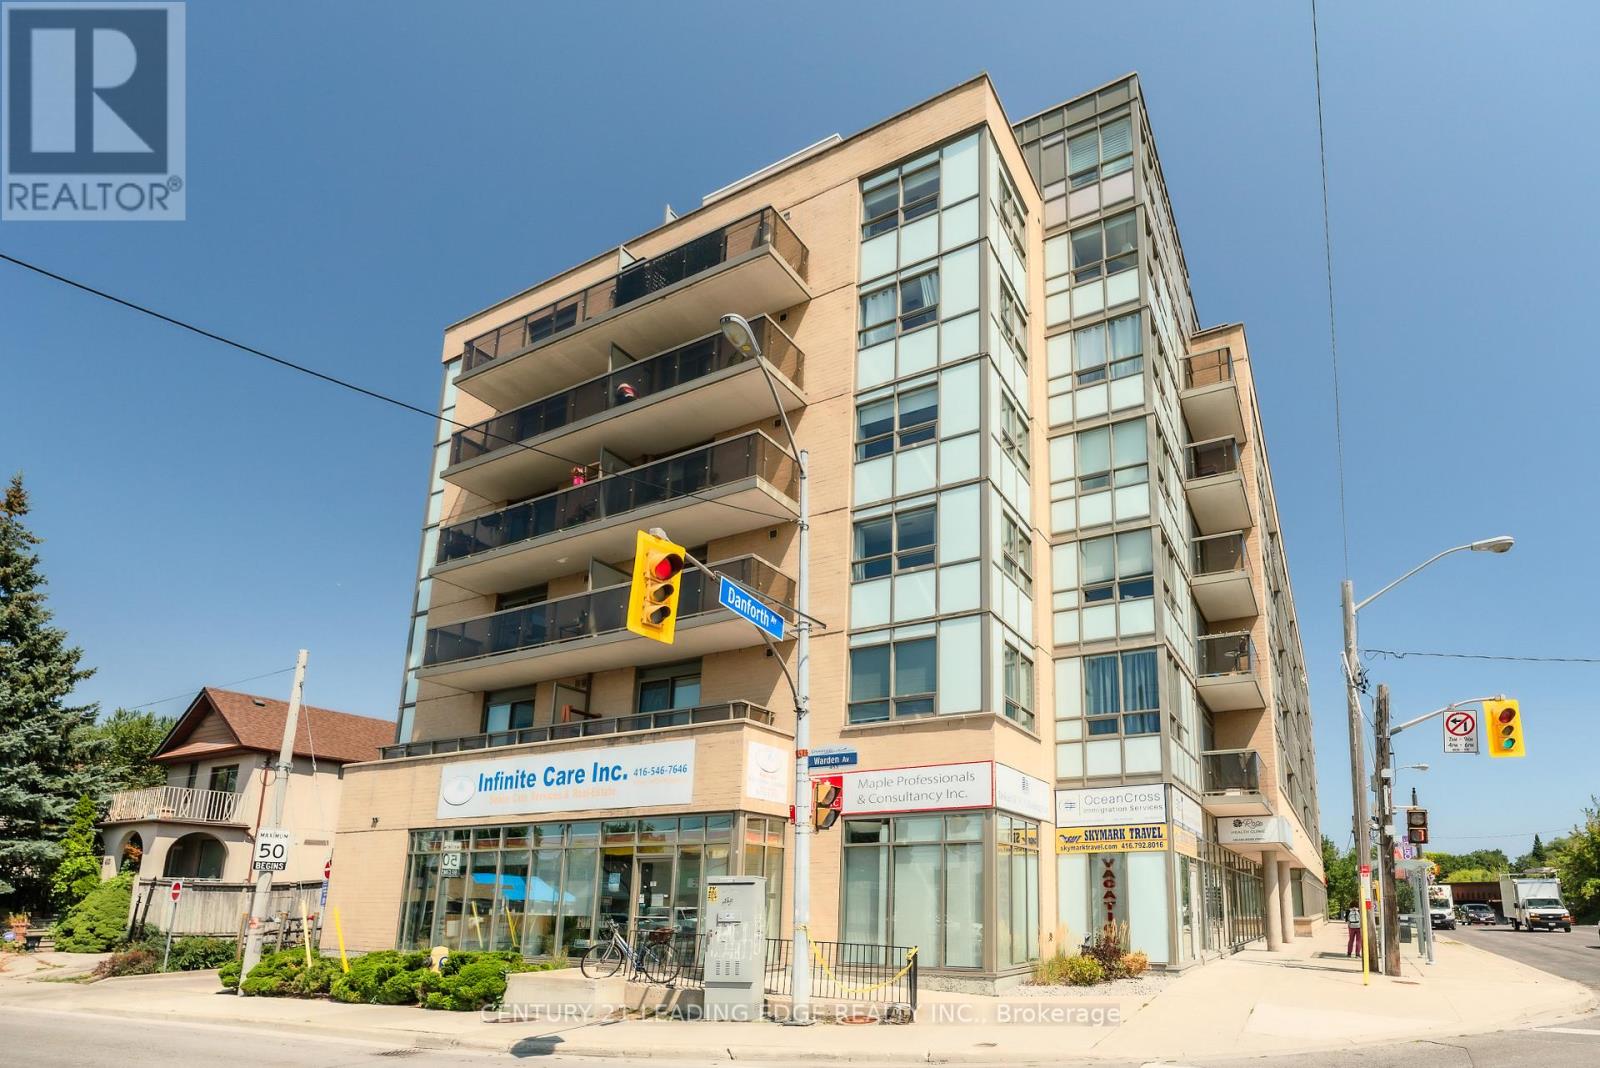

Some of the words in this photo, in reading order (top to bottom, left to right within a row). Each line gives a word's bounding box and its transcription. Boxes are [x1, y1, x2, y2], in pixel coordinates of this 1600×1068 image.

[728, 587, 769, 627] Danforth
[813, 756, 840, 765] Warden
[478, 769, 537, 792] Infinite
[543, 765, 586, 787] Care
[592, 761, 628, 783] Inc.
[633, 763, 688, 777] 416-546-7646
[857, 778, 894, 790] Maple
[897, 771, 976, 788] Professionals
[857, 794, 867, 804] &
[868, 790, 943, 804] Consultancy
[946, 788, 968, 799] Inc.
[1084, 792, 1161, 806] OceanCross
[1130, 803, 1163, 811] Services
[1084, 828, 1126, 841] SKYMARK
[1129, 826, 1163, 839] TRAVEL
[259, 843, 285, 859] 50
[1060, 842, 1118, 852] skymarktravel.com
[1121, 841, 1163, 849] 416.792.8016
[255, 861, 285, 870] BEGINS
